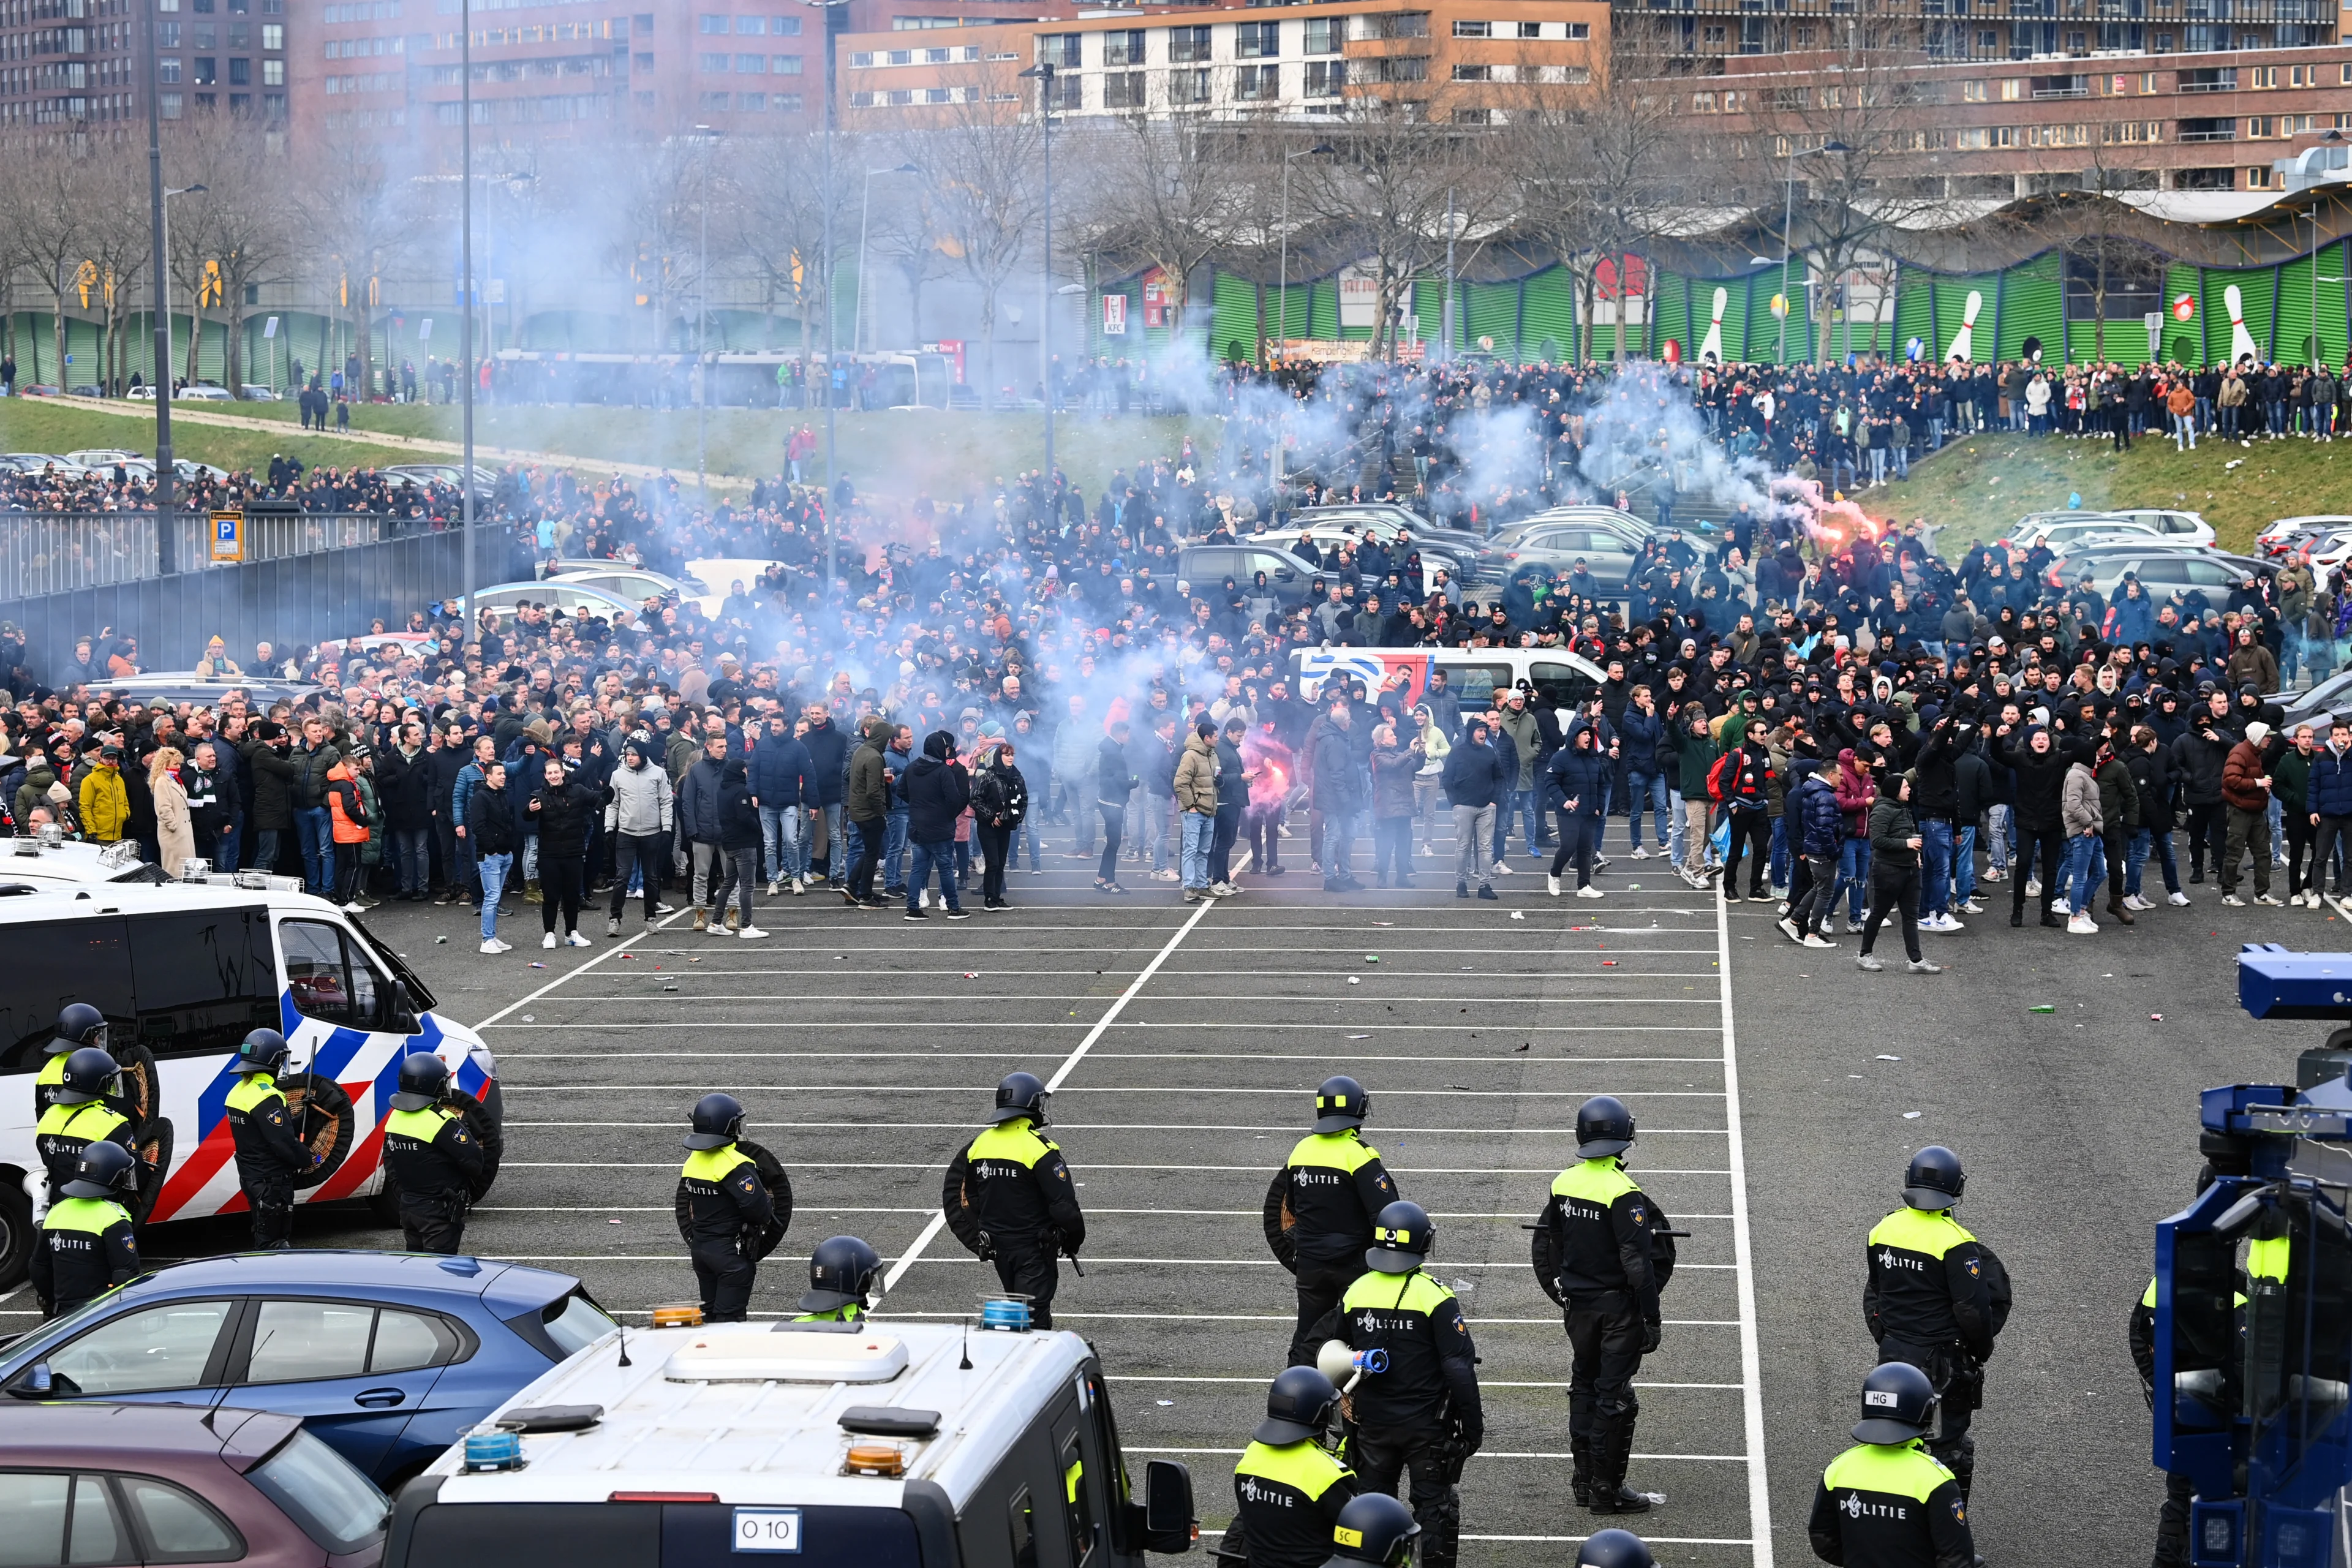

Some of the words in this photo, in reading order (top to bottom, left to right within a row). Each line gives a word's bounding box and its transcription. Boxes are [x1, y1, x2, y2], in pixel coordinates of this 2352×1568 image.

[1107, 323, 1121, 332] KFC
[923, 344, 938, 353] KFC
[221, 522, 232, 538] P
[229, 1114, 245, 1125] LITIE
[977, 1159, 1017, 1179] POLITIE
[1294, 1166, 1340, 1187] POLITIE
[1559, 1197, 1600, 1221] POLITIE
[49, 1230, 92, 1252] POLITIE
[1879, 1246, 1924, 1271] POLITIE
[816, 1266, 822, 1278] HG
[1872, 1393, 1887, 1404] HG
[1241, 1476, 1293, 1507] POLITIE
[1840, 1490, 1906, 1520] POLITIE
[765, 1521, 789, 1539] 10
[1339, 1530, 1351, 1542] SC
